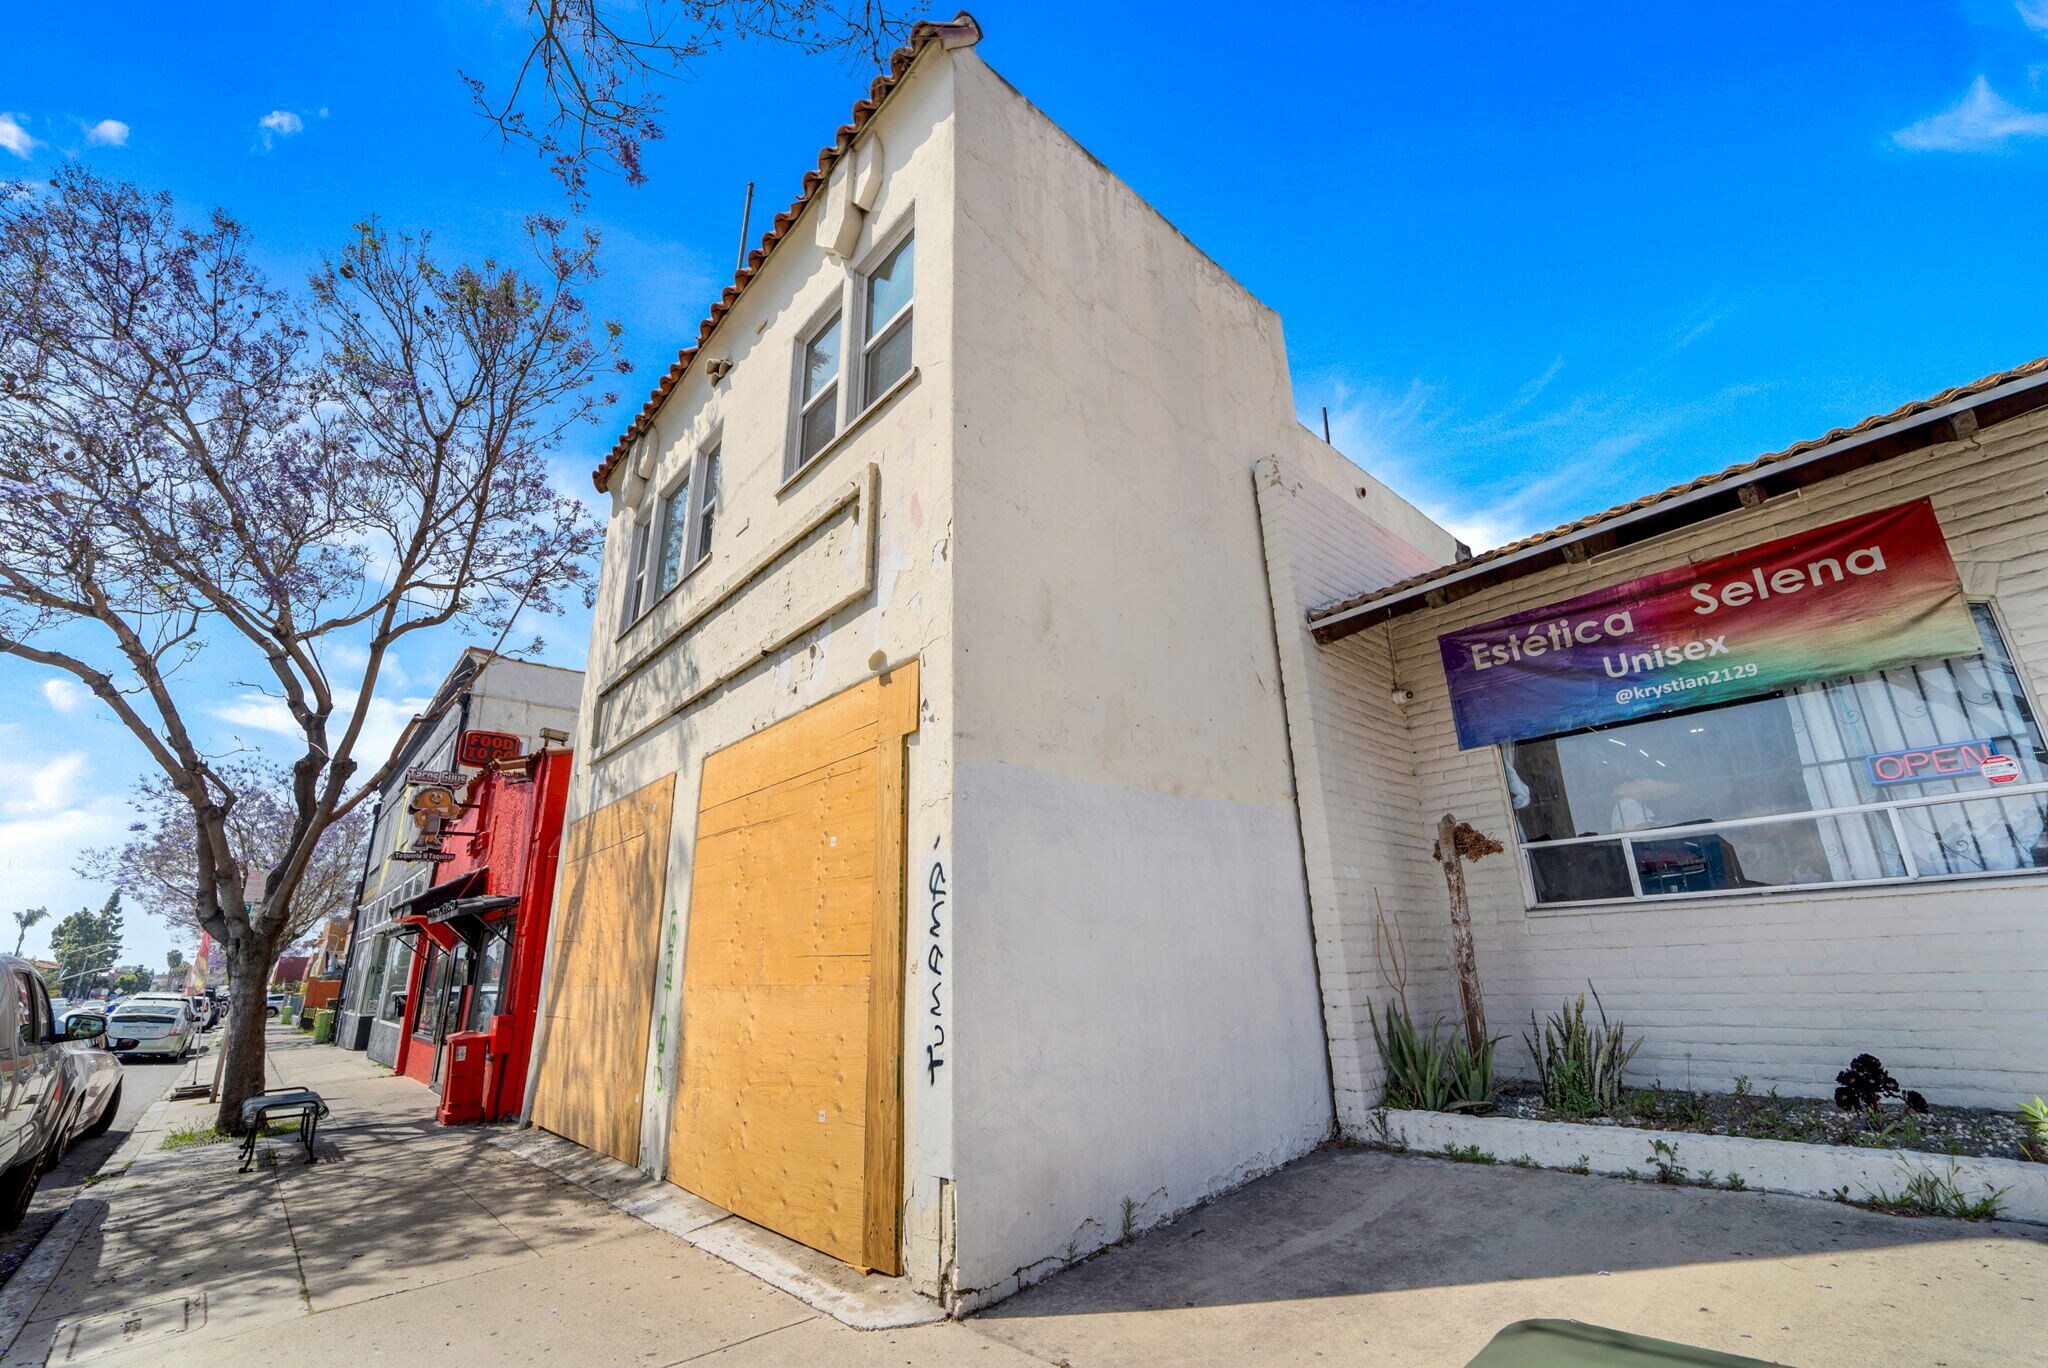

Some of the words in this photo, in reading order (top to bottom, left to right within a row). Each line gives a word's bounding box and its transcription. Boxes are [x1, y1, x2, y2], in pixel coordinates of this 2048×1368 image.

[1470, 610, 1635, 671] Estética
[1690, 545, 1887, 615] Selena
[1602, 634, 1730, 678] Unisex
[1615, 662, 1758, 704] @krystian2129
[467, 746, 489, 759] TO
[469, 735, 513, 750] FOOD
[408, 768, 439, 782] Tacos
[1875, 743, 1990, 780] OPEN
